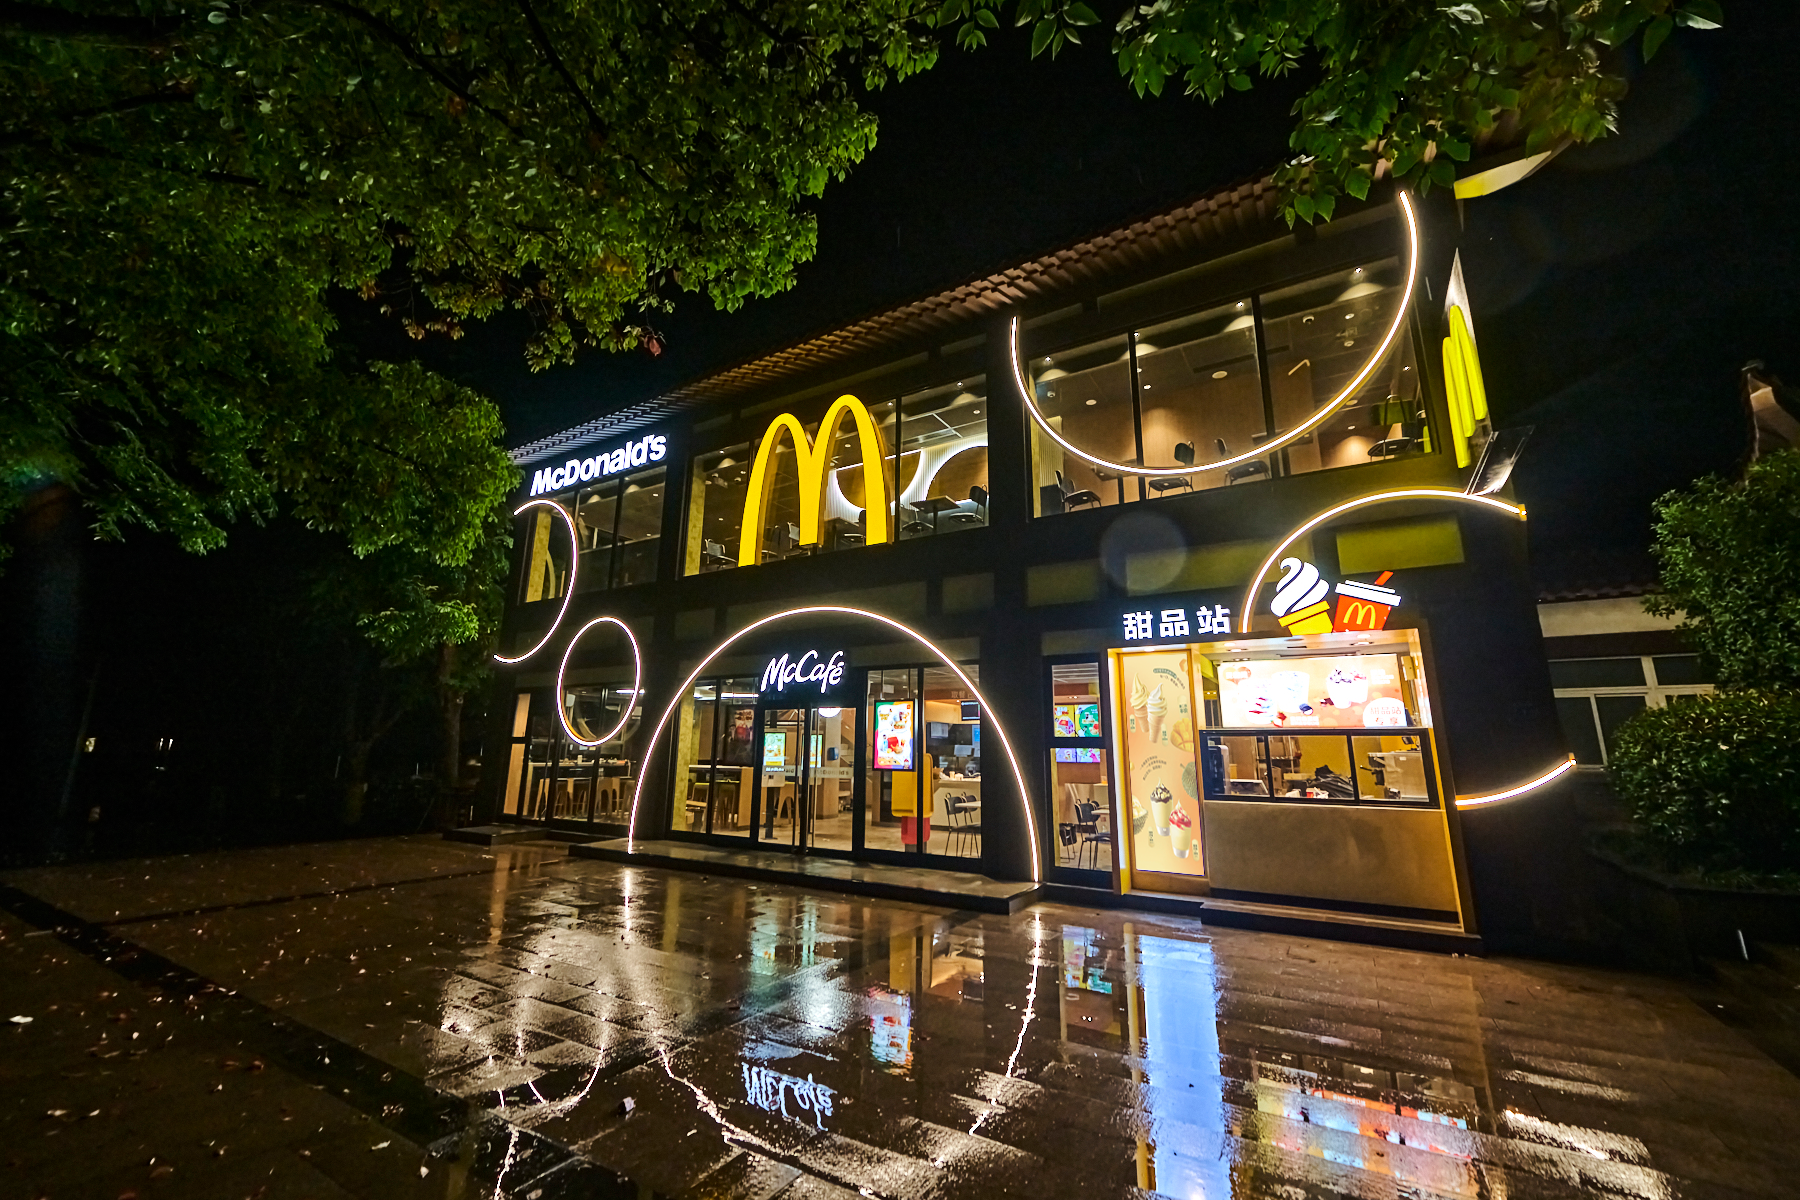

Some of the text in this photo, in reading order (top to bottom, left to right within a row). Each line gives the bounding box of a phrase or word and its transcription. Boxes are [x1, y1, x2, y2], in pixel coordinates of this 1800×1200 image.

[530, 434, 666, 495] McDonald's
[1122, 605, 1231, 640] 甜品站
[760, 650, 845, 693] McCafé
[1370, 706, 1402, 715] 甜品站
